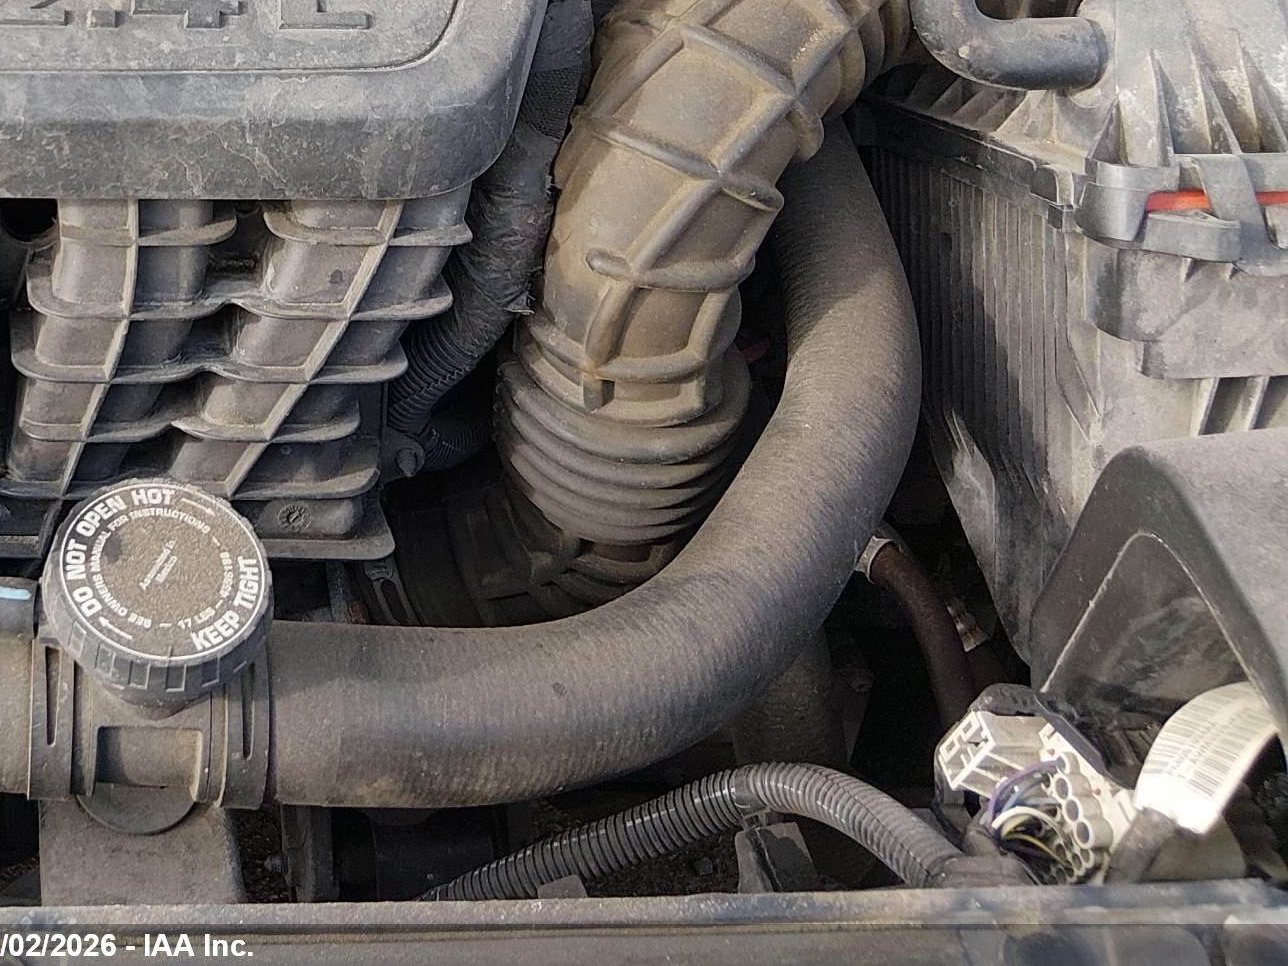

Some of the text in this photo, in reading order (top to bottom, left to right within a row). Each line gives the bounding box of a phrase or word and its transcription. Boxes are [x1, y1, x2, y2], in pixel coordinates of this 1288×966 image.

[108, 514, 129, 531] FOR
[129, 507, 211, 534] INSTRUCTIONS
[66, 488, 176, 617] DO NOT OPEN HOT
[90, 531, 112, 572] MANUAL
[92, 574, 128, 617] OWNERS
[191, 556, 260, 650] KEEP TIGHT
[128, 611, 152, 628] SEE
[178, 617, 192, 630] 17
[194, 607, 216, 624] LBS
